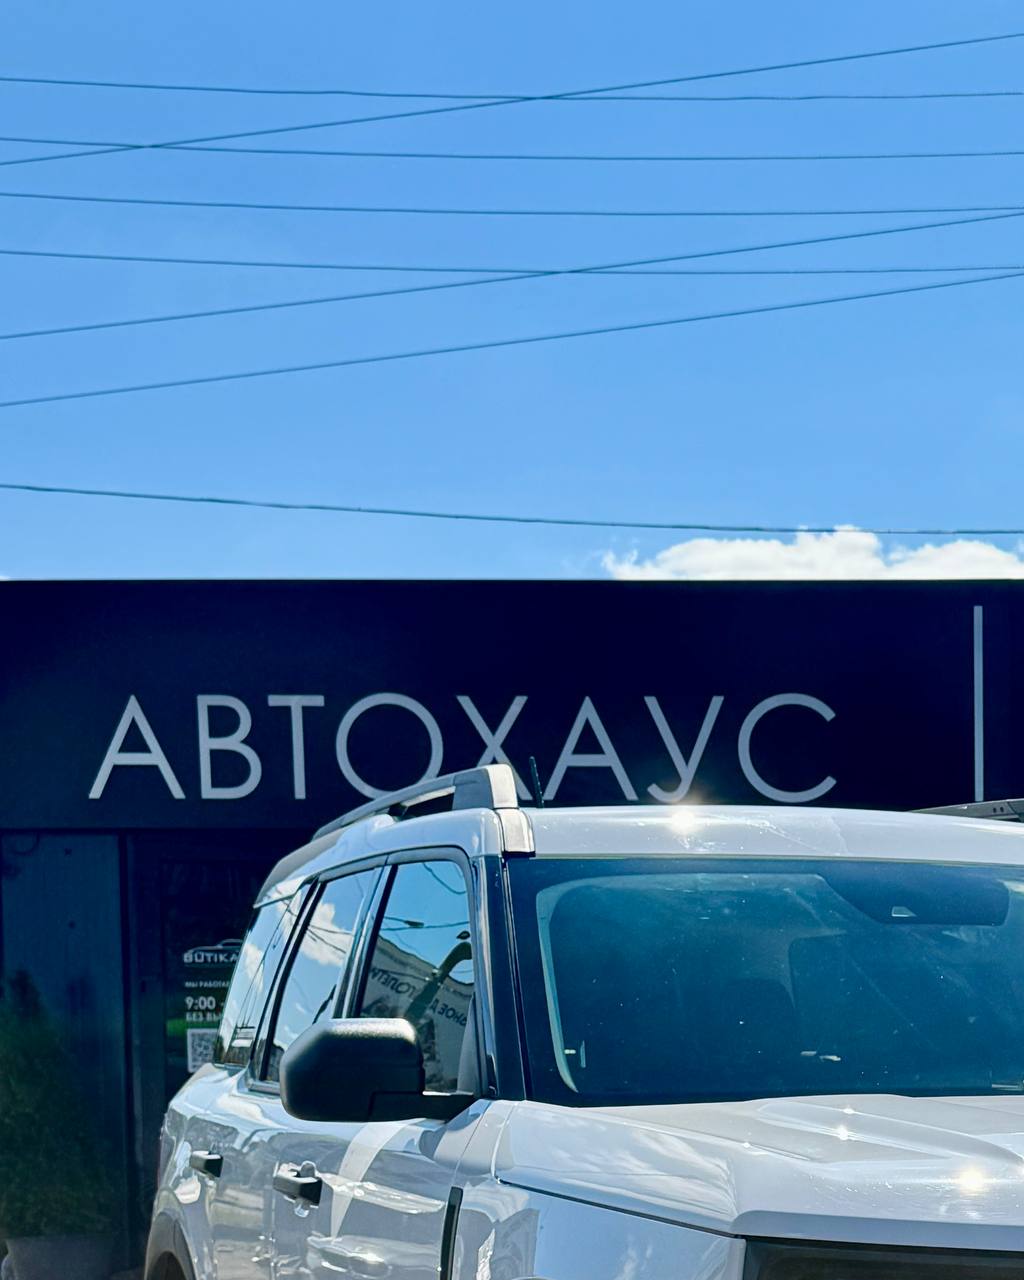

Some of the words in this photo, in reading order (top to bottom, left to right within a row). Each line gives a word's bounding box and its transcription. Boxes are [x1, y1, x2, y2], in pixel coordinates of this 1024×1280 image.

[89, 693, 837, 803] АВТОХАУС
[183, 952, 240, 963] BUTIKA
[185, 996, 216, 1010] 9:00
